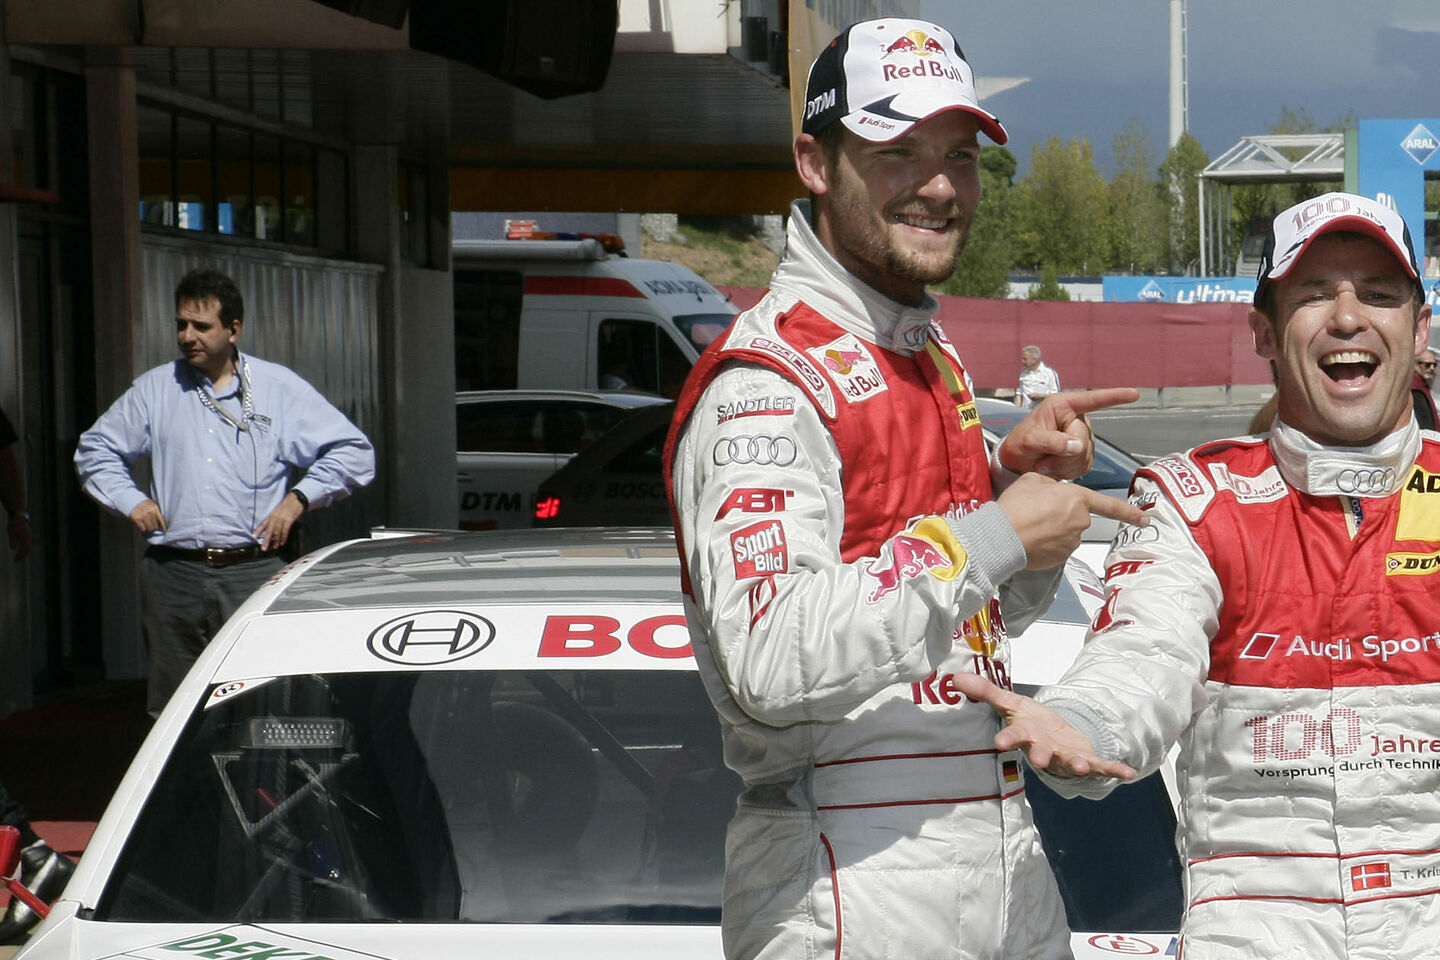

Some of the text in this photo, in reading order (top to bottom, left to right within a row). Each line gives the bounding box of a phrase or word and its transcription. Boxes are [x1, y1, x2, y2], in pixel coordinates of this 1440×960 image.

[883, 59, 964, 84] Red Bull
[806, 88, 836, 121] DTM
[880, 120, 896, 132] Sport
[1405, 137, 1440, 150] ARAL
[858, 366, 885, 394] Bull
[461, 492, 522, 511] DTM
[714, 488, 795, 522] ABT
[734, 522, 783, 564] Sport
[754, 551, 785, 574] Bild
[1285, 635, 1353, 661] Audi
[911, 669, 983, 706] Re
[1245, 707, 1362, 764] 100
[1254, 764, 1335, 780] Vorsprung
[1338, 758, 1383, 773] durch
[1401, 869, 1415, 880] T.
